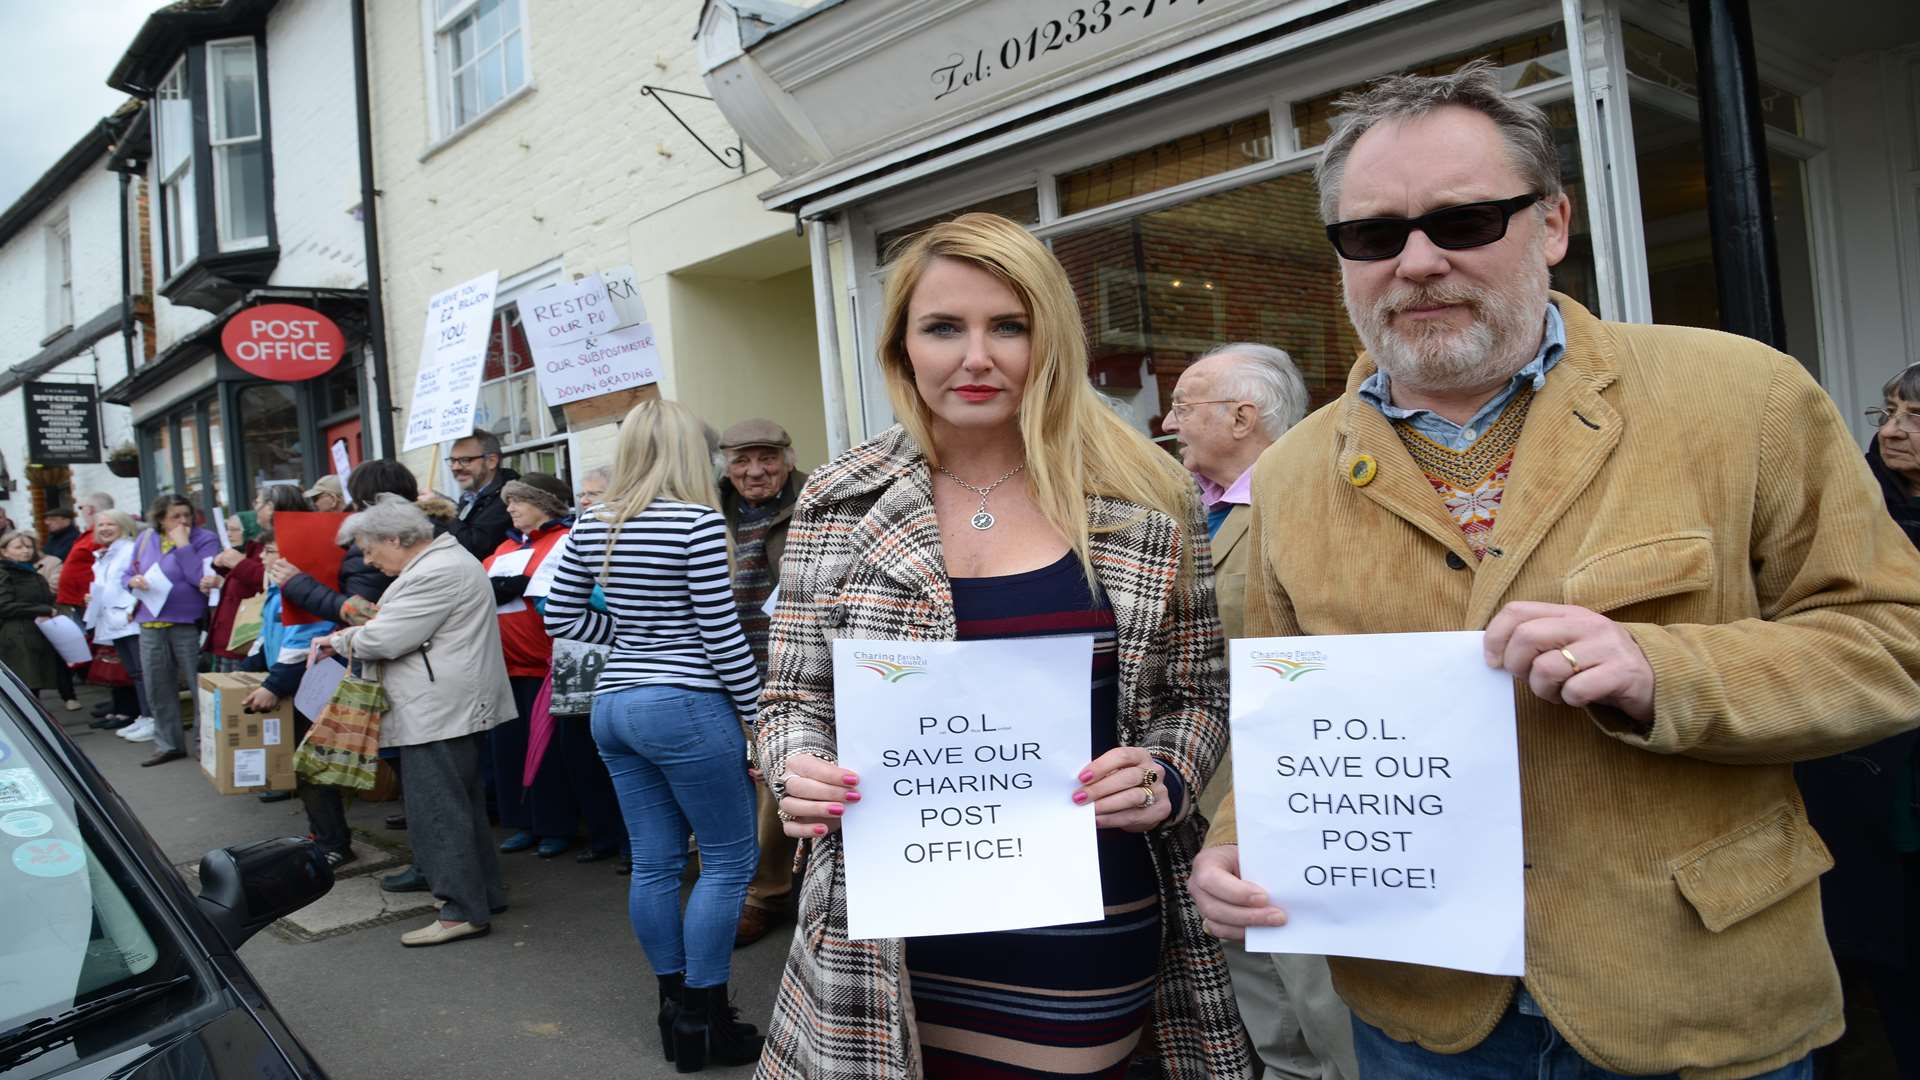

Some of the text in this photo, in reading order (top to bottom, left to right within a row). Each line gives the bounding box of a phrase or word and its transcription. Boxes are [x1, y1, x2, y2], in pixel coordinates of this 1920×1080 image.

[930, 49, 991, 101] Tel:
[251, 320, 319, 339] POST
[548, 318, 582, 337] OUR
[236, 341, 332, 361] OFFICE
[546, 336, 654, 373] OUR SUBPOSTMASTER
[585, 337, 598, 350] &
[592, 363, 611, 377] NO
[854, 651, 895, 662] Charing
[1313, 718, 1406, 741] P.O.L.
[882, 743, 1042, 768] SAVE OUR
[1277, 755, 1452, 779] SAVE OUR
[893, 772, 1033, 797] CHARING
[1288, 792, 1443, 816] CHARING
[920, 805, 1002, 828] POST
[904, 838, 1022, 864] OFFICE!
[1322, 829, 1413, 853] POST
[1304, 865, 1436, 889] OFFICE!
